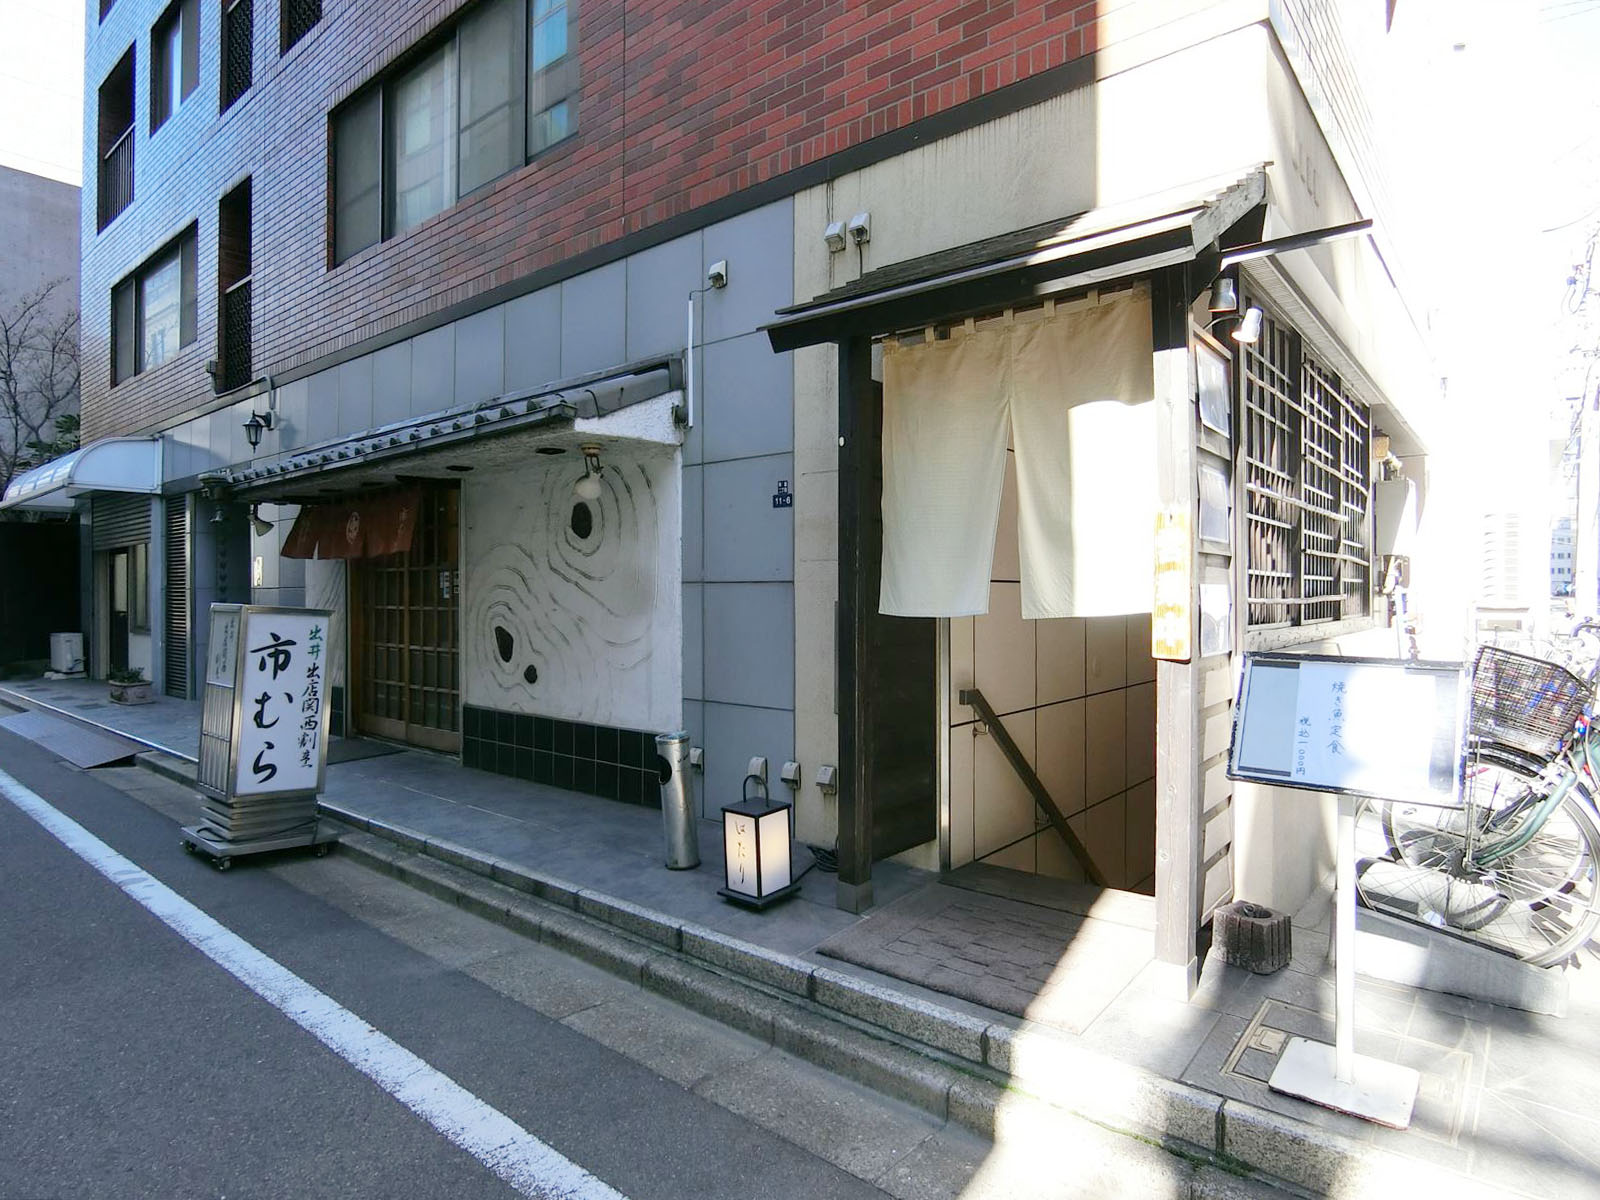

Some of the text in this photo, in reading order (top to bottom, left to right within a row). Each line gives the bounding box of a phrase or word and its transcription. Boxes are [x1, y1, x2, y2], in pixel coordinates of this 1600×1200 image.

[250, 632, 297, 784] 市むら
[1327, 681, 1347, 755] 焼き魚定食
